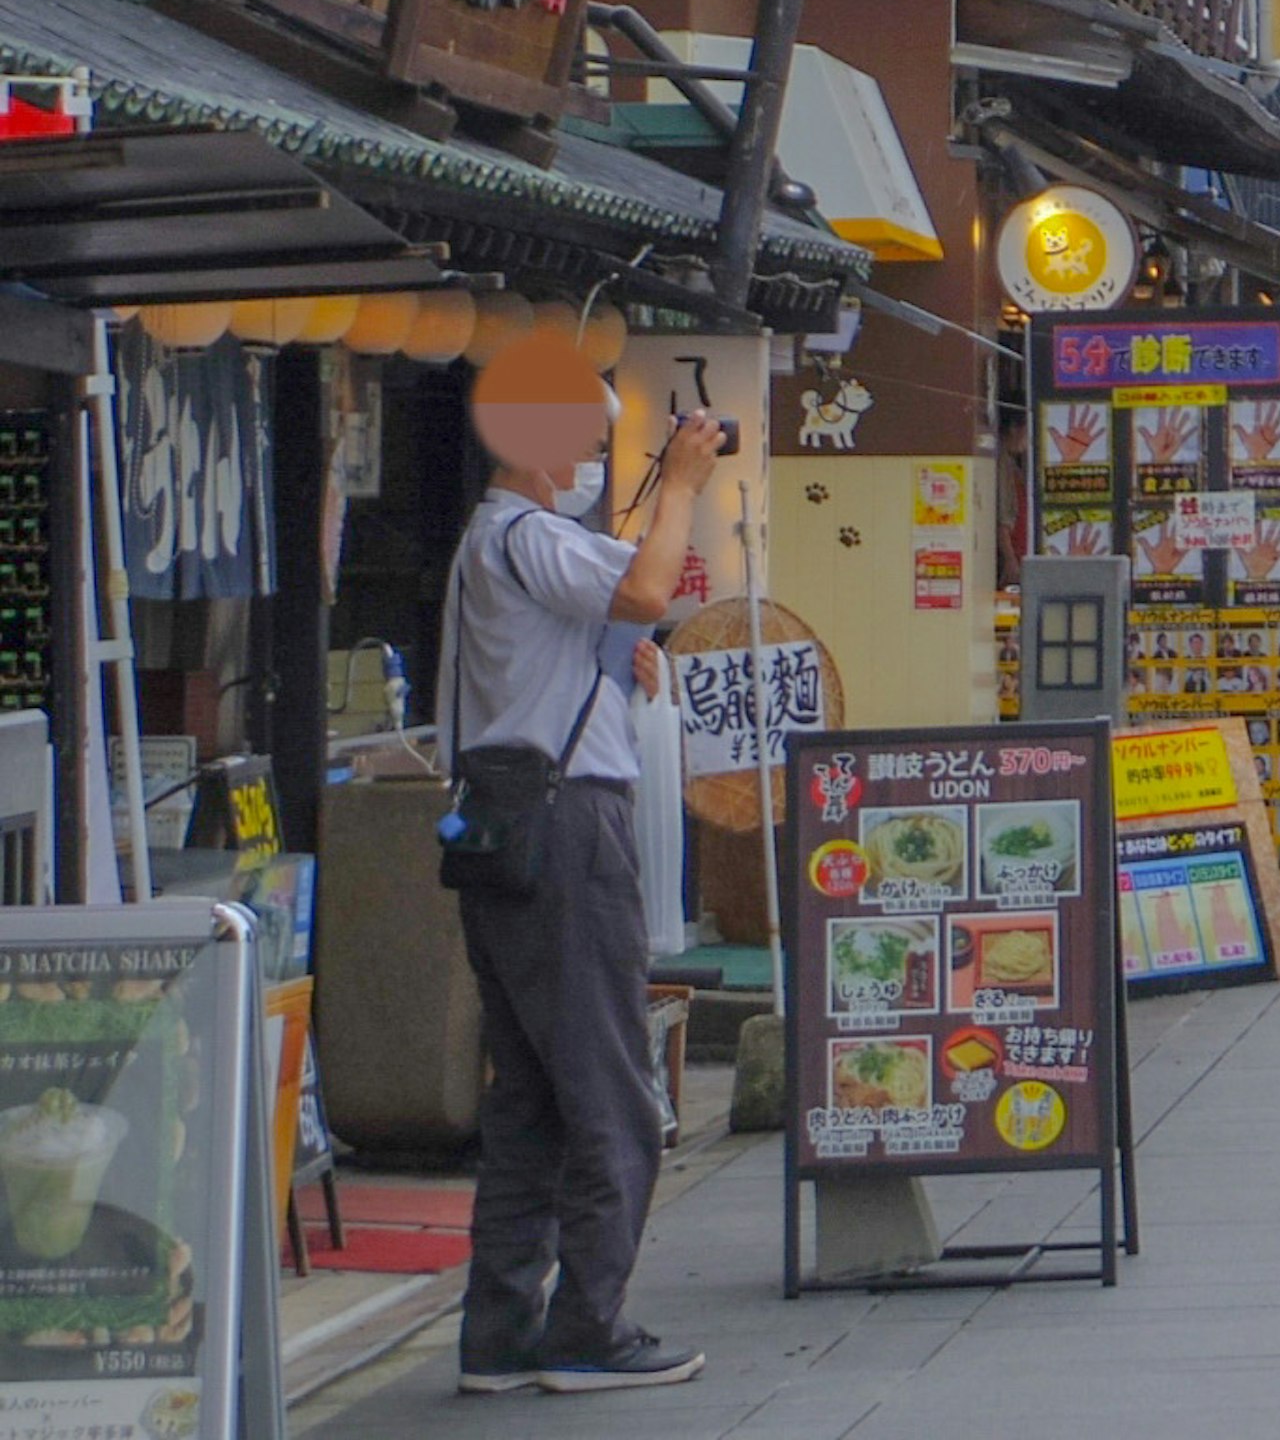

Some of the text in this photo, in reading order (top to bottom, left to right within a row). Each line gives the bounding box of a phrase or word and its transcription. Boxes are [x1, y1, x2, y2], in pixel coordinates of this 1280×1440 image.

[868, 750, 995, 780] 讃岐うどん
[929, 779, 989, 798] UDON
[880, 880, 919, 898] かけ
[19, 948, 195, 972] MATCHA SHAKE
[841, 981, 900, 1000] しょうゆ
[809, 1108, 873, 1128] 肉うどん
[96, 1350, 147, 1372] ¥550
